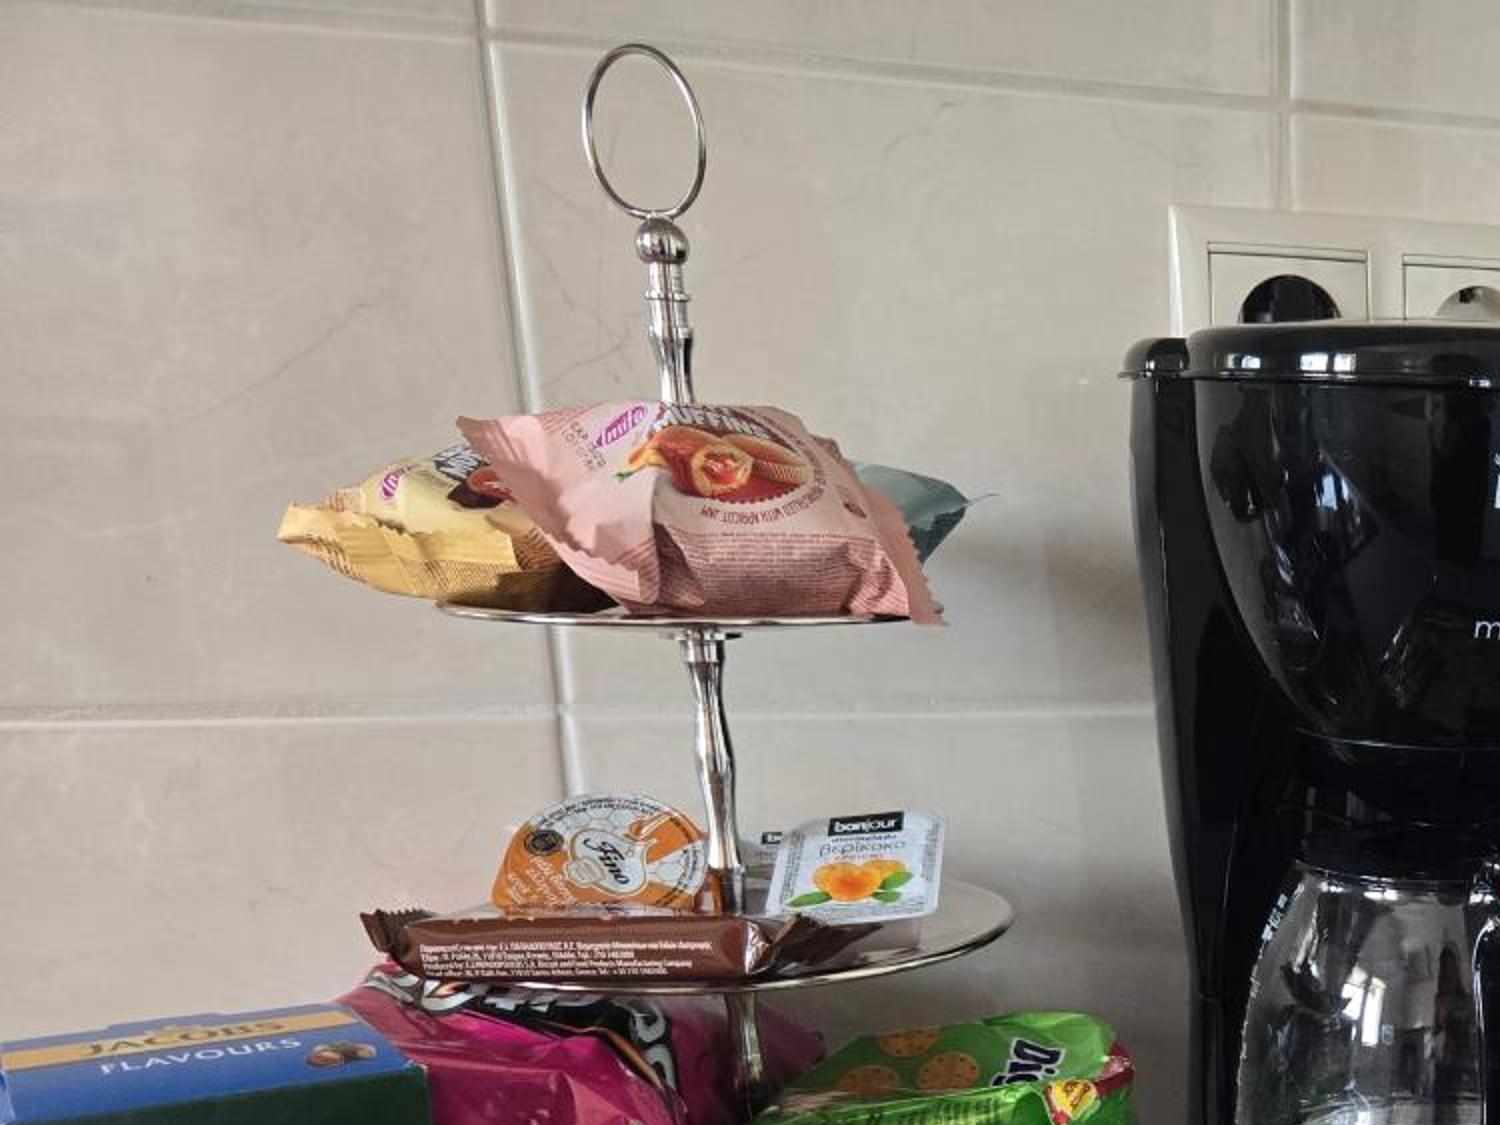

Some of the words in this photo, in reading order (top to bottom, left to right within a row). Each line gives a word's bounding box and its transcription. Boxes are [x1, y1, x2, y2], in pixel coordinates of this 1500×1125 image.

[834, 818, 898, 833] bonjour
[86, 1019, 286, 1057] JACOBS
[101, 1036, 302, 1075] FLAVOURS
